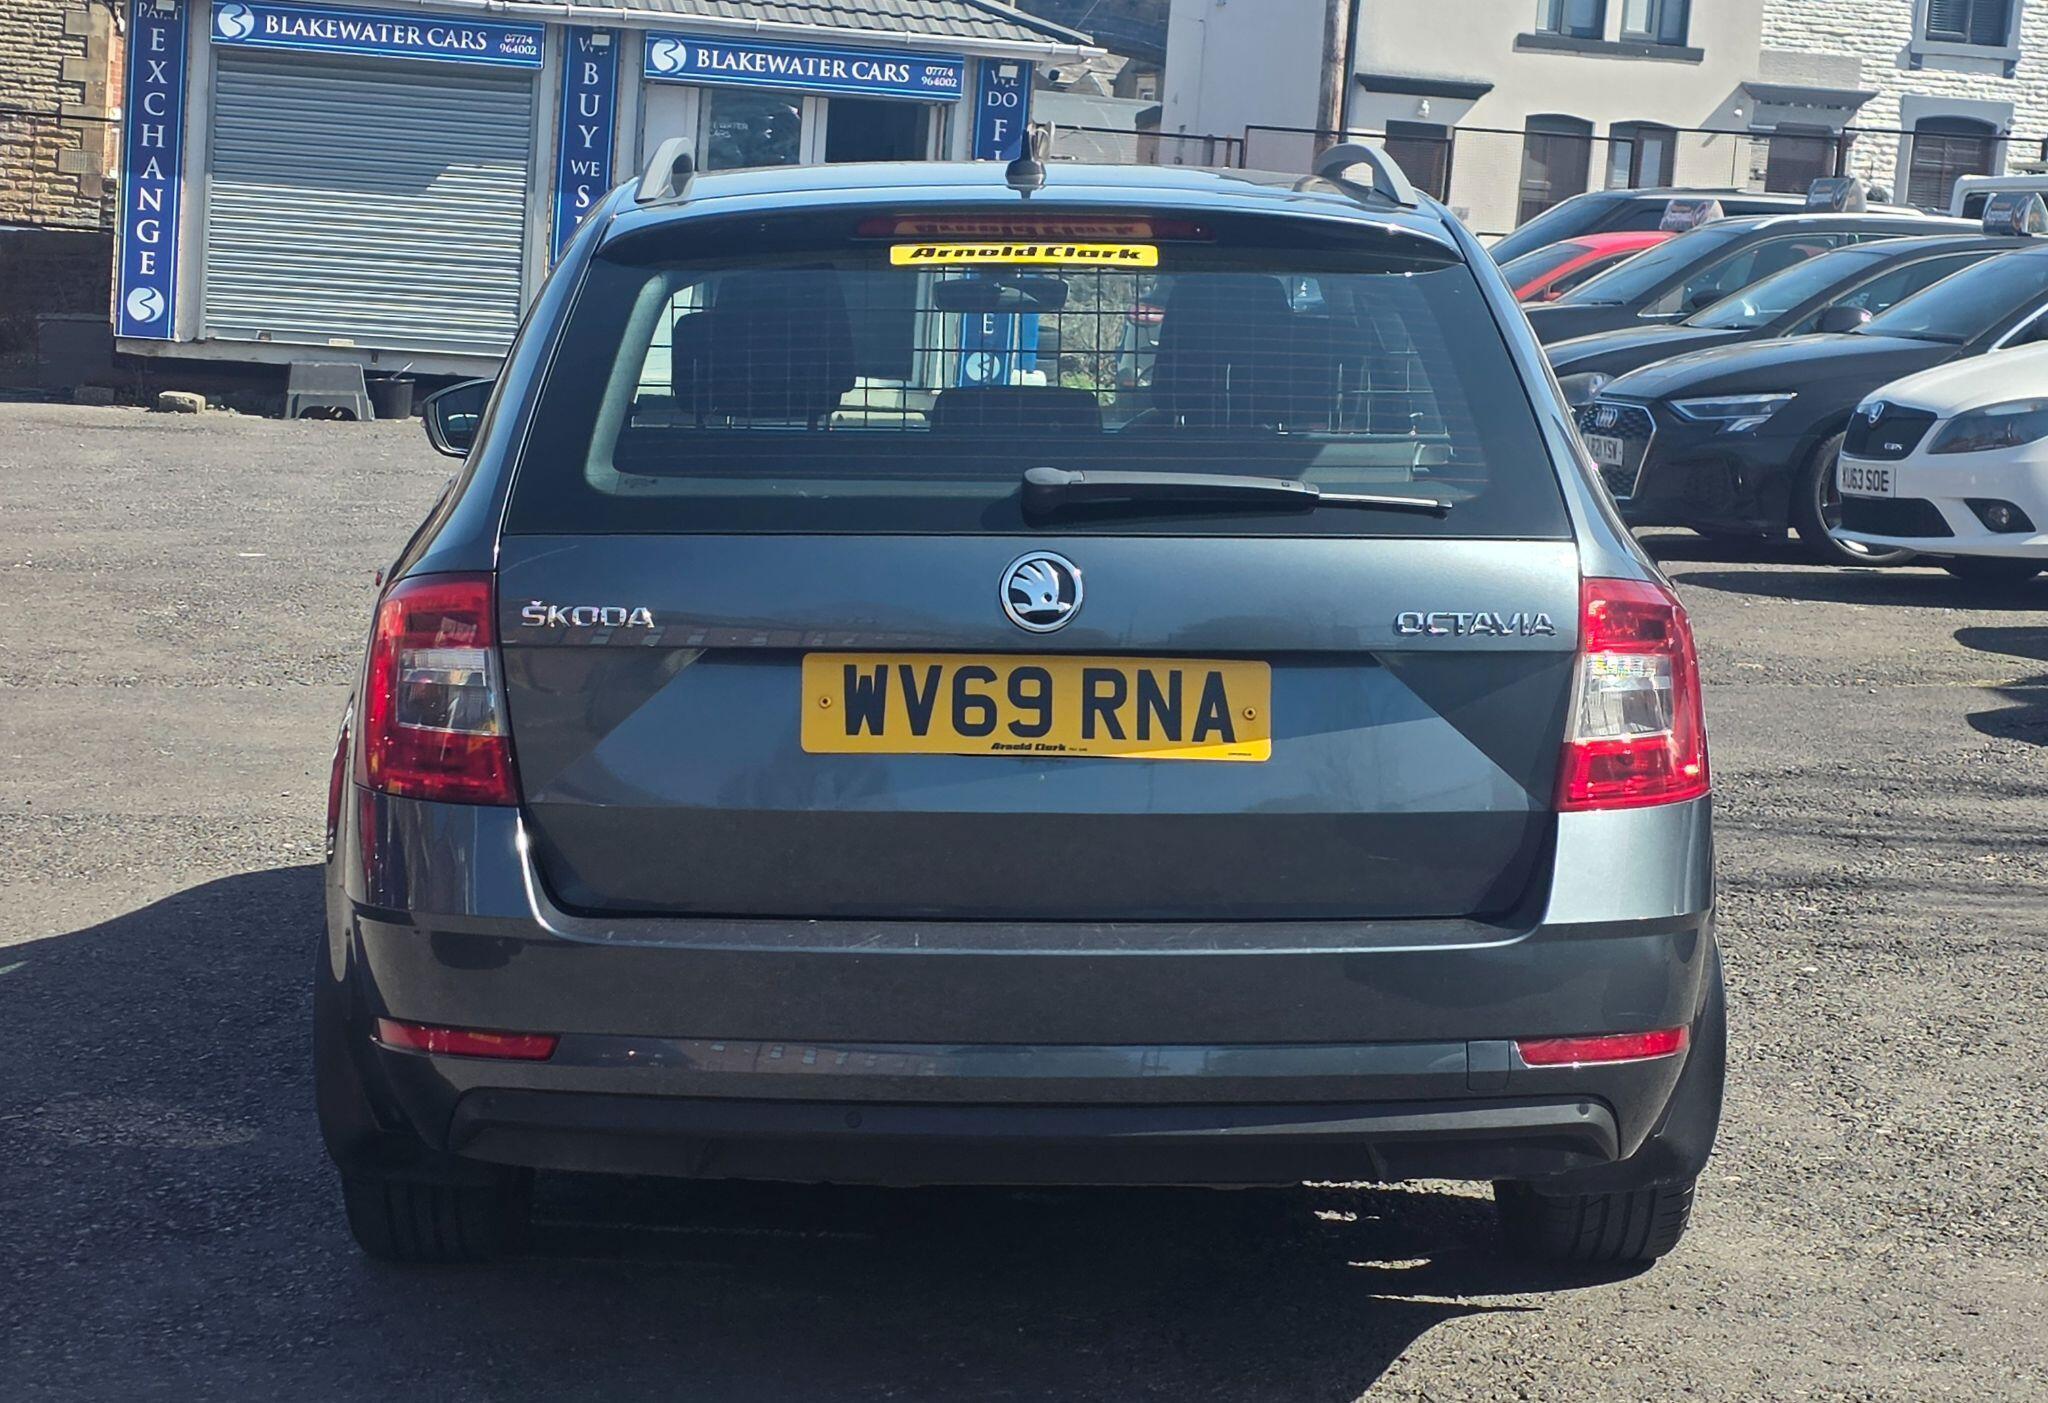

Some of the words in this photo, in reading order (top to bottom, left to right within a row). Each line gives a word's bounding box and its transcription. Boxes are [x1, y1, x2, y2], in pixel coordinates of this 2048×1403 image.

[265, 14, 423, 46] BLAKEWATER
[427, 28, 487, 50] CARS
[504, 33, 533, 44] 07774
[500, 43, 537, 55] 964002
[696, 48, 847, 79] BLAKEWATER
[852, 60, 910, 83] CARS
[926, 66, 954, 77] 07774
[921, 76, 957, 87] 964002
[579, 62, 601, 148] BUY
[987, 91, 1018, 108] DO
[136, 27, 169, 275] EXCHANGE
[571, 159, 600, 177] WE
[910, 246, 1037, 259] Arnold
[1044, 246, 1141, 260] Clark
[521, 600, 656, 628] ŠKODA
[1395, 611, 1557, 636] OCTAVIA
[843, 664, 1053, 738] WV69
[1081, 667, 1237, 743] RNA
